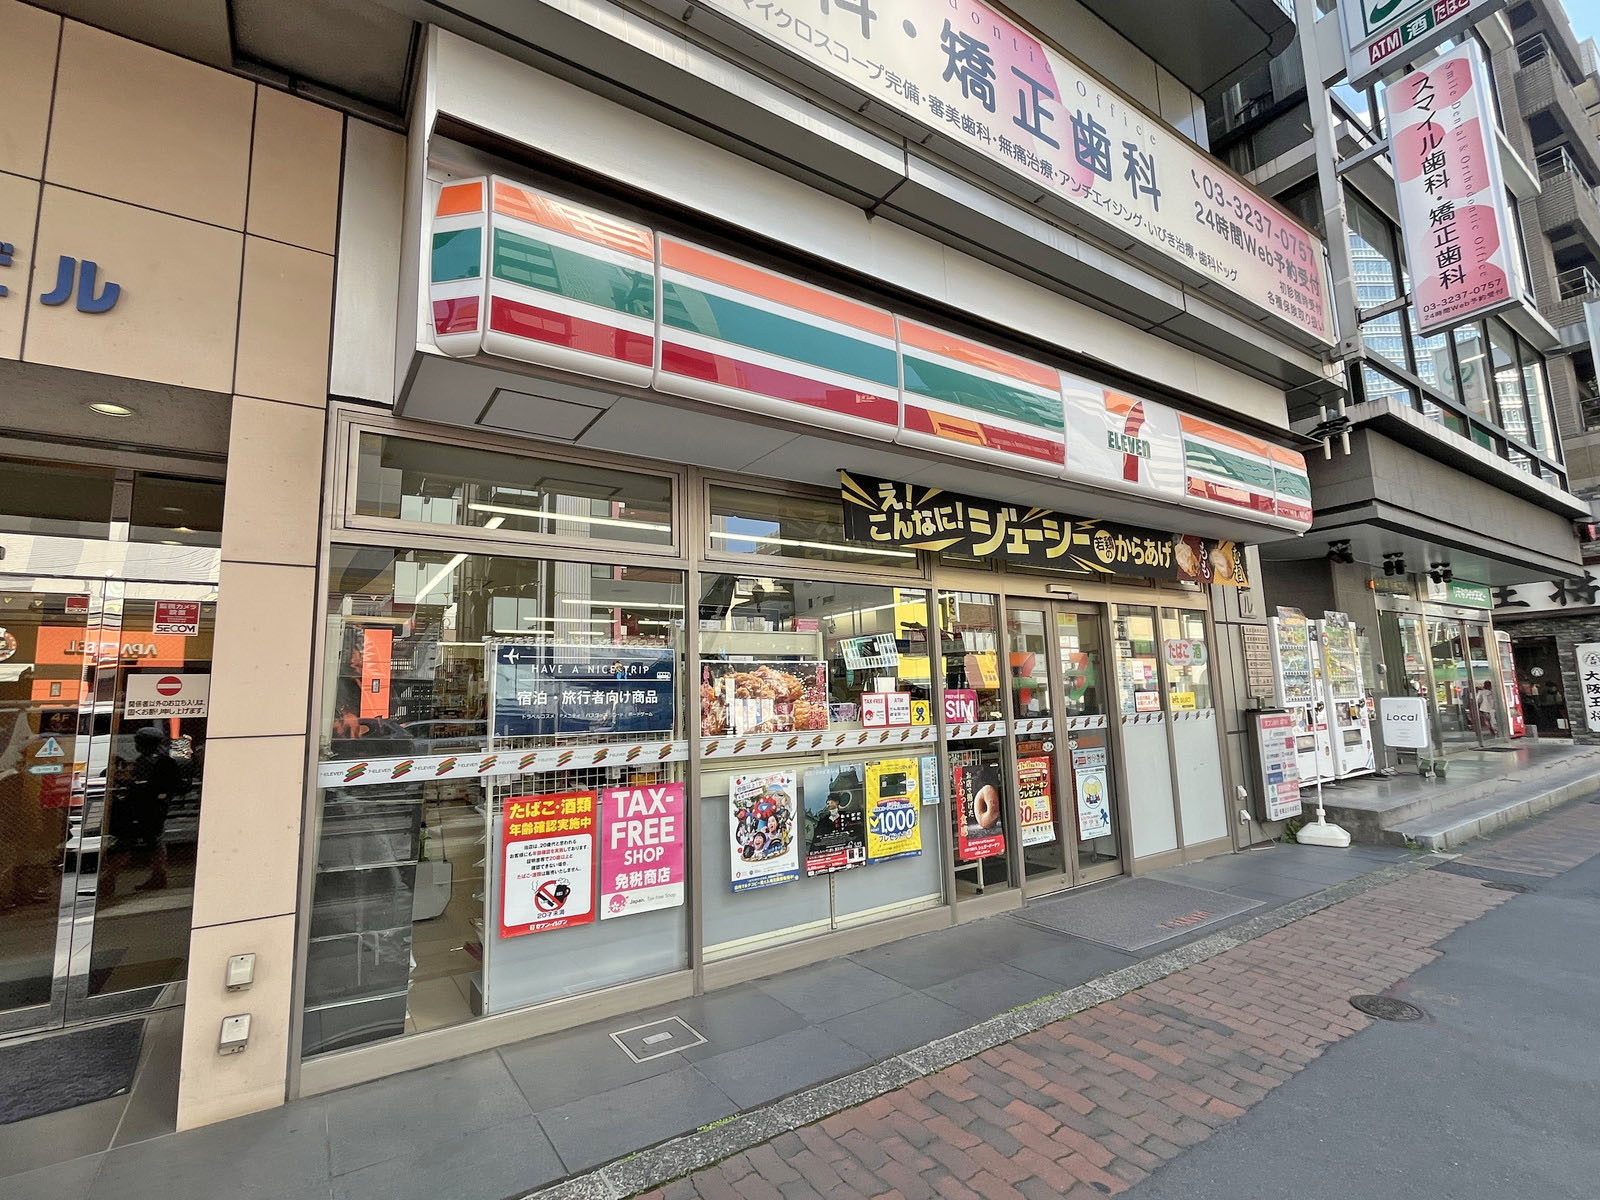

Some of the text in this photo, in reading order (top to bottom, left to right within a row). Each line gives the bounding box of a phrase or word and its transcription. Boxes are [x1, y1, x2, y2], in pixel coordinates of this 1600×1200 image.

[1406, 14, 1428, 40] 酒
[1371, 32, 1400, 62] ATM
[1076, 80, 1157, 145] Office
[1412, 75, 1466, 290] スマイル歯科・矯正歯科
[1444, 62, 1457, 97] Smile
[1451, 101, 1465, 143] Dental
[1459, 155, 1480, 231] Orthodontic
[1474, 236, 1488, 279] Office
[1202, 174, 1314, 267] 03-3237-0757
[1194, 200, 1320, 297] 24時間Web予約受付
[1423, 278, 1501, 312] 03-3237-0757
[968, 507, 1091, 559] ジューシー
[1115, 533, 1173, 569] からあげ
[156, 624, 196, 633] SECOM
[531, 664, 650, 675] HAVE A NICE TRIP
[517, 689, 659, 706] 宿泊・旅行者向け商品
[945, 699, 975, 719] SIM
[1386, 713, 1418, 722] Local
[508, 796, 592, 819] たばこ・酒類
[611, 787, 675, 819] TAX-
[508, 816, 592, 837] 年齢確認実施中
[611, 815, 676, 850] FREE
[623, 846, 665, 866] SHOP
[614, 867, 671, 891] 免税商店
